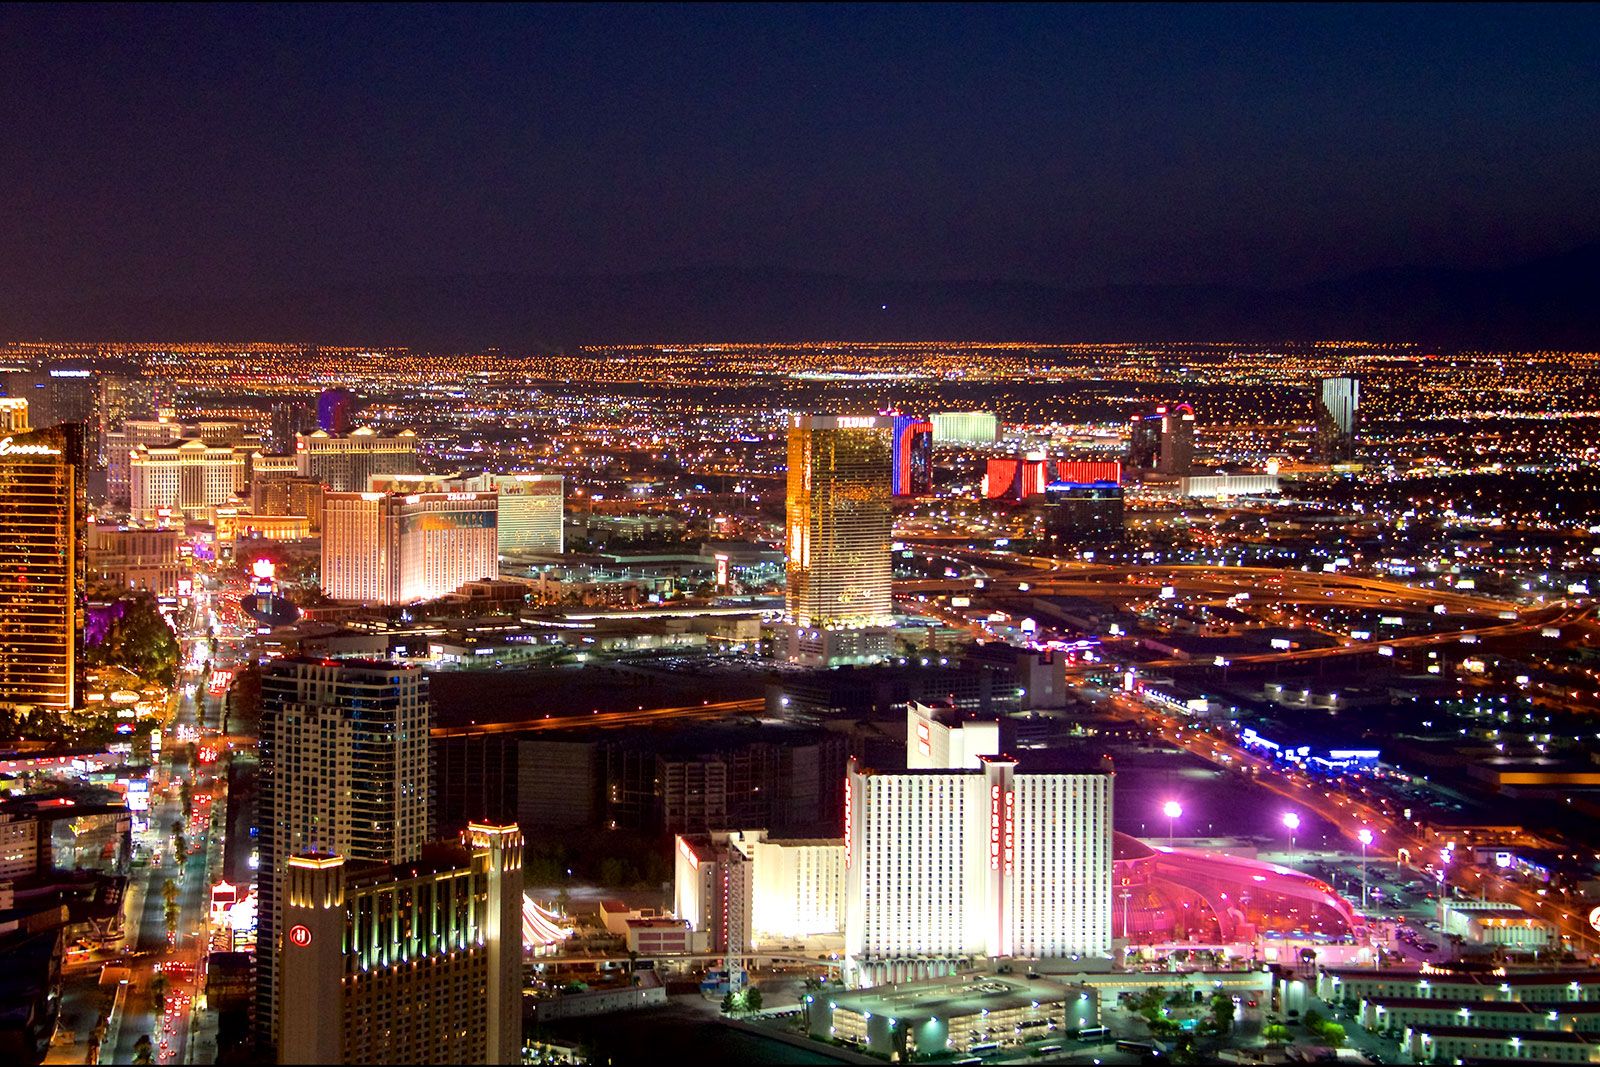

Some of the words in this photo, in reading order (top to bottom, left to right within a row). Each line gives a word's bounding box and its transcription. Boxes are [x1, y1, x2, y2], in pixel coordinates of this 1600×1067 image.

[836, 416, 875, 428] TRUMP
[447, 492, 476, 501] ISLAND
[991, 785, 1000, 870] CIRCUS
[1004, 791, 1013, 876] CIRCUS
